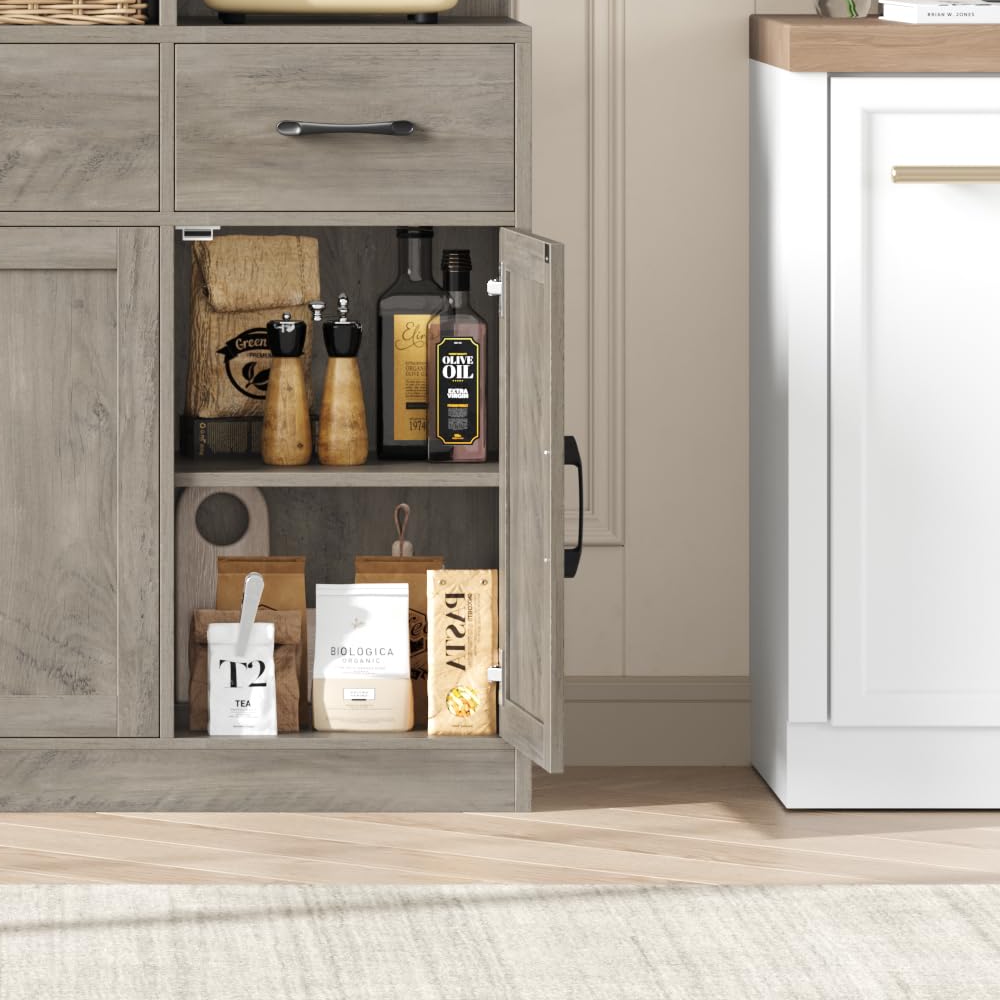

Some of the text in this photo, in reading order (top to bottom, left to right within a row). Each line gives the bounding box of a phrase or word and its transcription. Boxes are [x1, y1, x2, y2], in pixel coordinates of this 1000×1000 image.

[235, 338, 267, 350] Green
[442, 355, 474, 365] OLIVE
[442, 365, 474, 379] OIL
[330, 646, 394, 656] BIOLOGICA
[219, 659, 267, 688] T2
[235, 700, 251, 708] TEA
